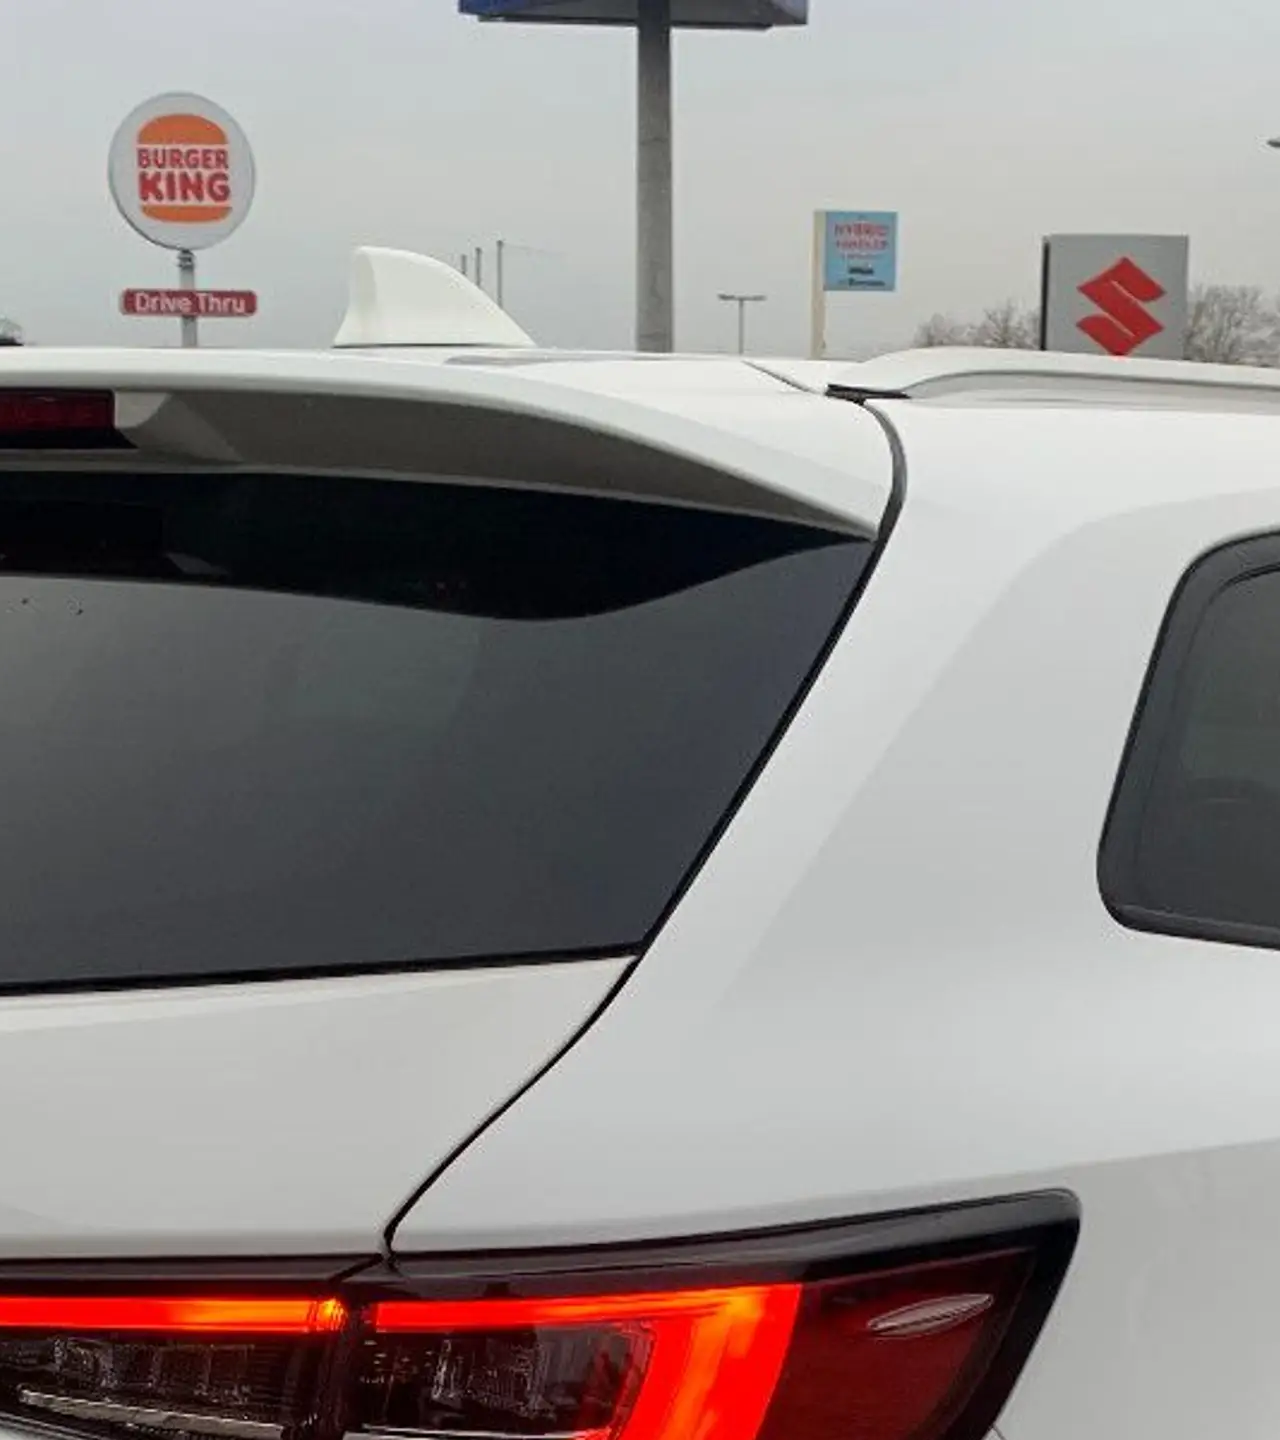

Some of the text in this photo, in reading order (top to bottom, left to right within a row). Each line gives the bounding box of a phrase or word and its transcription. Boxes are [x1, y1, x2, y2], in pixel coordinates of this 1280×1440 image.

[137, 147, 229, 169] BURGER
[138, 171, 231, 202] KING
[135, 292, 246, 313] Drive Thru
